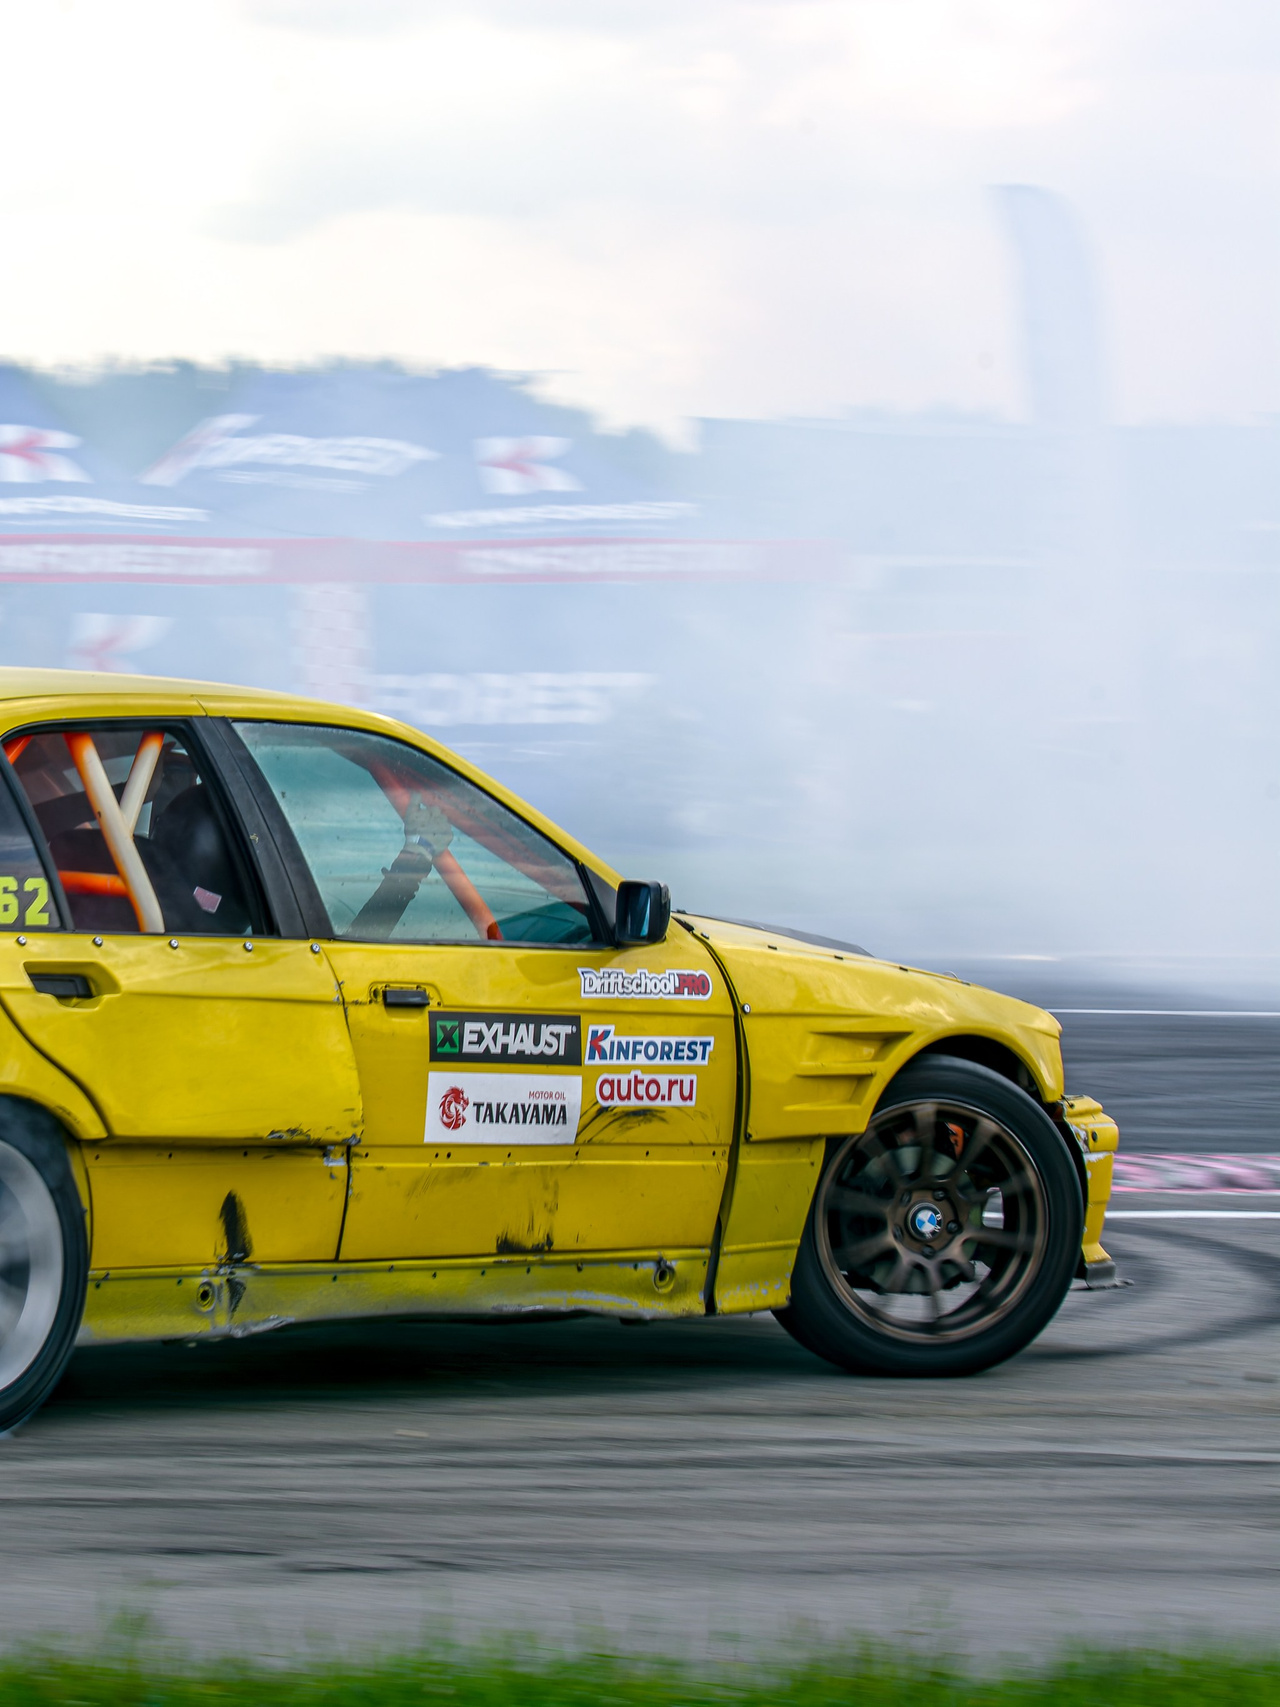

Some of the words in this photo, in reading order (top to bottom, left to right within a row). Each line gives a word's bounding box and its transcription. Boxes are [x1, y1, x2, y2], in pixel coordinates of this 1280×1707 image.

[581, 970, 711, 996] Driftschool.PRO
[461, 1021, 573, 1057] EXHAUST
[587, 1029, 712, 1062] KINFOREST
[528, 1090, 554, 1100] MOTOR
[554, 1091, 566, 1101] OIL
[598, 1074, 695, 1103] auto.ru
[472, 1101, 568, 1126] TAKAYAMA
